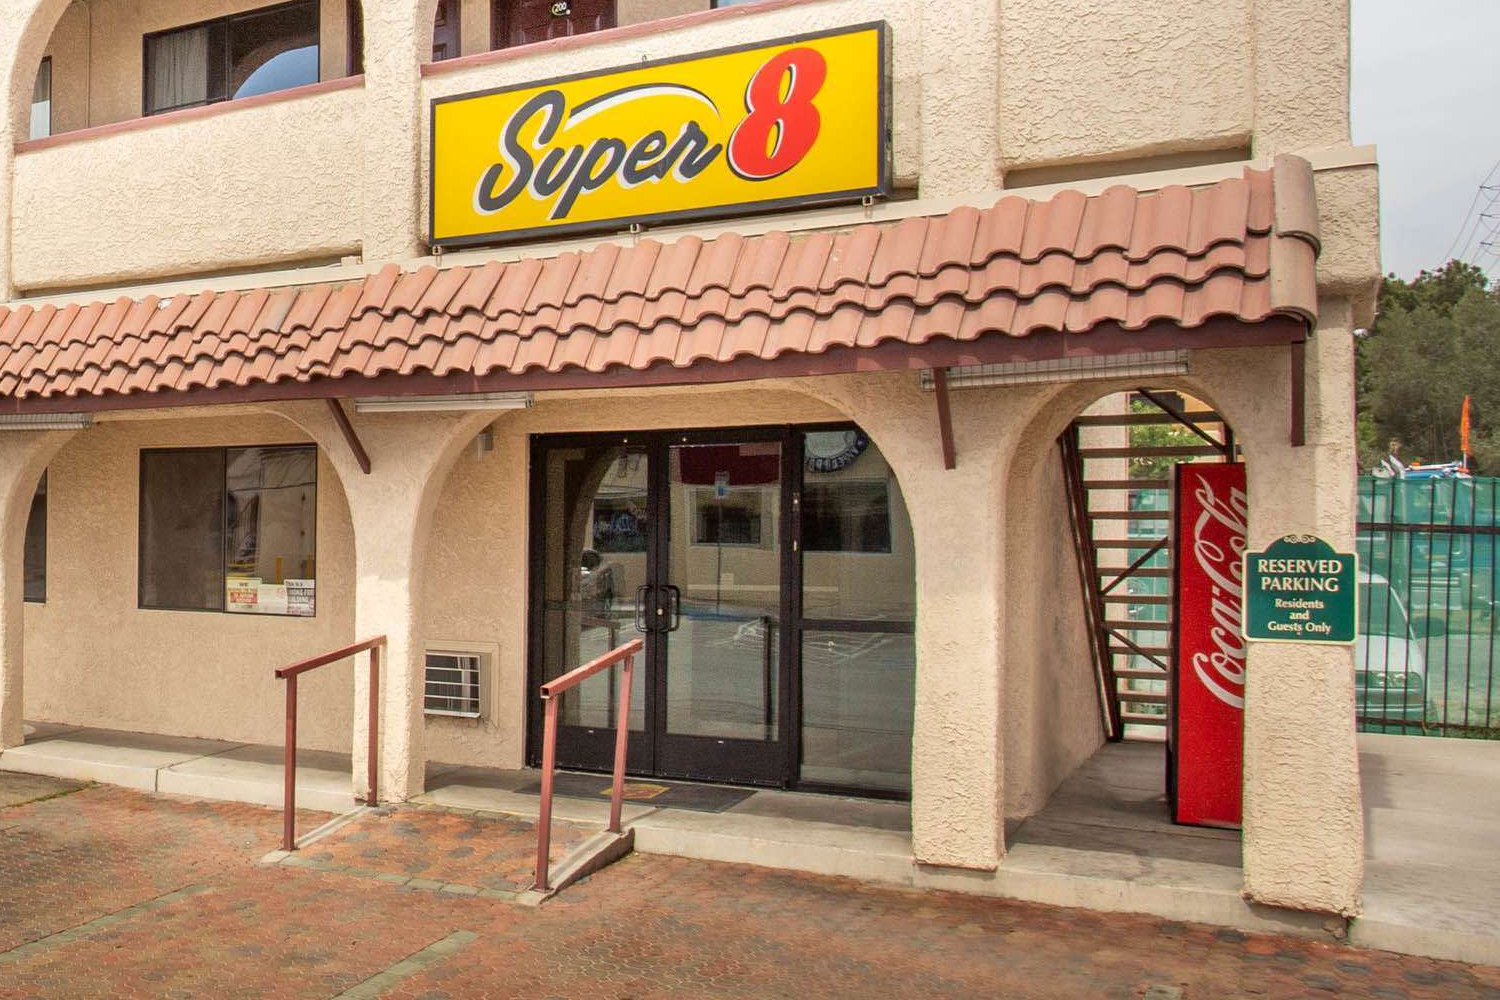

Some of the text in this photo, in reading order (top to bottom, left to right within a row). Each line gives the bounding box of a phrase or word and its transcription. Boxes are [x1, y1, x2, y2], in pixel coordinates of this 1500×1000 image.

[473, 47, 827, 220] Super 8
[1257, 559, 1342, 574] RESERVED
[1261, 576, 1339, 592] PARKING
[1274, 598, 1324, 609] Residents
[1289, 610, 1310, 620] and
[1267, 621, 1332, 635] Guests Only
